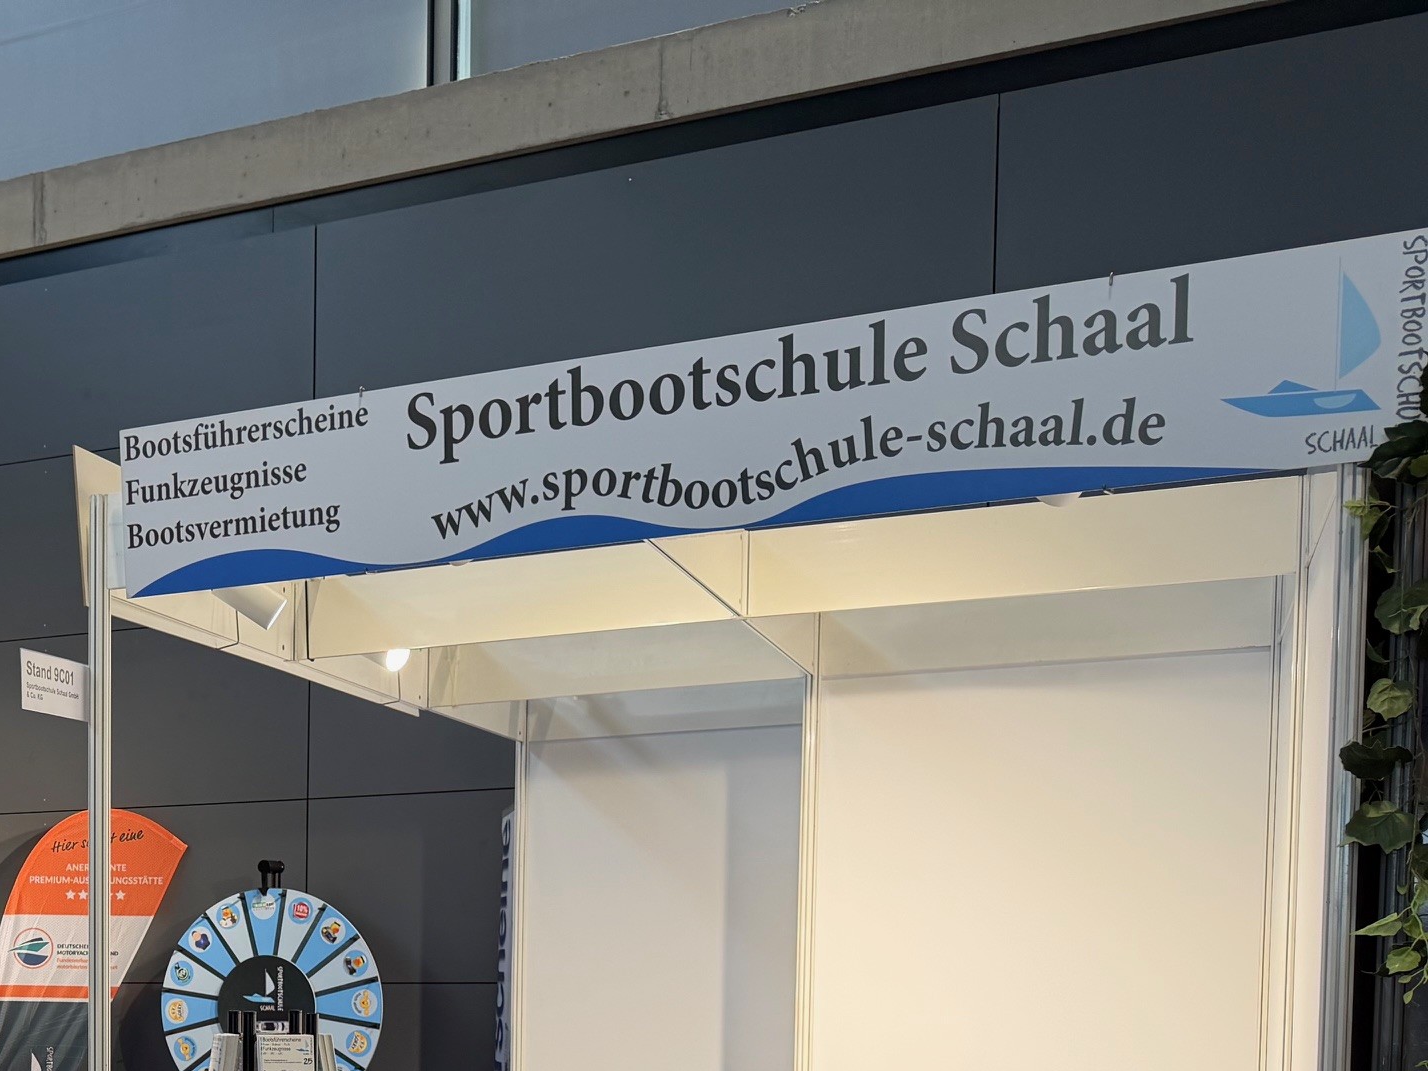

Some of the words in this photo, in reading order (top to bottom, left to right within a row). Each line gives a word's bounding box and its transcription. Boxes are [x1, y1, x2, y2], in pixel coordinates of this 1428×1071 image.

[1395, 234, 1428, 421] SPORTBOOTSCHU
[406, 318, 927, 464] Sportbootschule
[950, 273, 1193, 375] Schaal
[124, 402, 369, 462] Bootsführerscheine
[1305, 425, 1379, 455] SCHAAL
[125, 460, 307, 506] Funkzeugnisse
[431, 396, 1166, 540] www.sportbootschule-schaal.de
[126, 500, 341, 550] Bootsvermietung
[26, 660, 52, 680] Stand
[54, 667, 74, 686] 9C01
[51, 839, 77, 853] Hier
[119, 829, 144, 842] eine
[29, 875, 164, 885] PREMIUM-AUSUNGSSTÄTTE
[66, 863, 127, 872] ANERNTE
